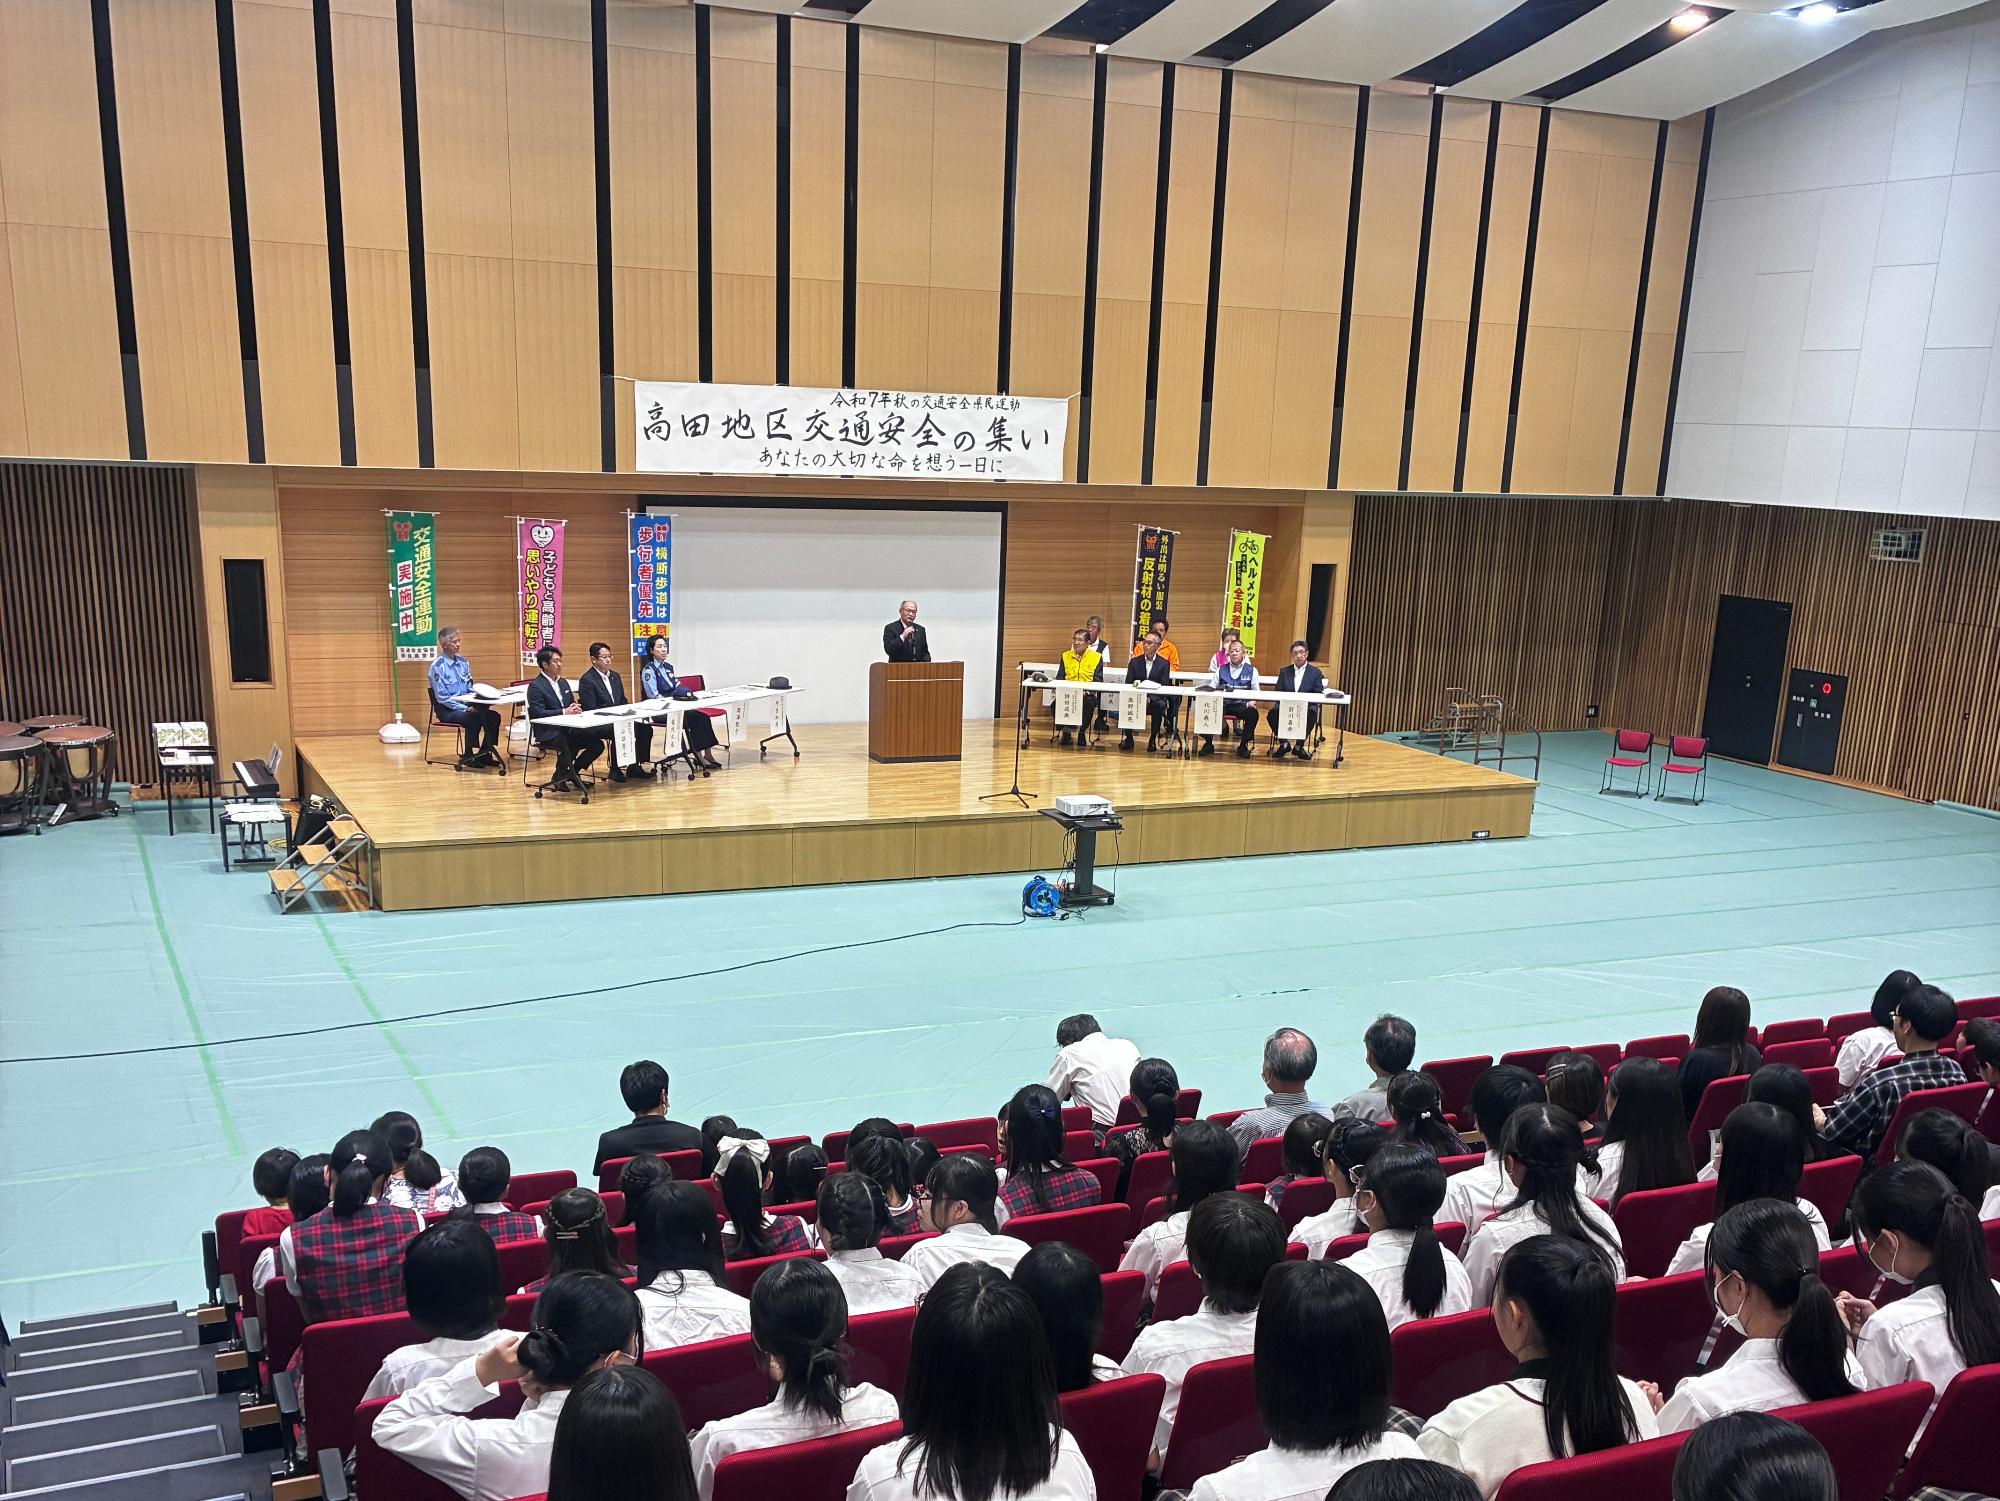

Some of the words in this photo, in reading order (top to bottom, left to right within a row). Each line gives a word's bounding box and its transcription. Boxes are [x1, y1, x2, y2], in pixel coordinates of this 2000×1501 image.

[643, 401, 1050, 453] 高田地区交通安全の集い
[829, 391, 1021, 411] 令和7年秋の交通安全県民運動
[759, 447, 1004, 475] あなたの大切な命を想う一日に
[398, 562, 413, 631] 実施中
[413, 526, 432, 636] 交通安全運動
[524, 549, 541, 650] 思いやり運転を
[541, 550, 557, 647] 子どもと高齢者に
[637, 526, 653, 618] 歩行者優先
[655, 546, 668, 618] 横断歩道は
[1138, 557, 1156, 639] 反射材の着用
[1156, 534, 1169, 611] 外出は明るい服装
[1231, 587, 1244, 629] 全員着
[1243, 556, 1259, 628] ヘルメットは
[638, 624, 667, 638] 注意
